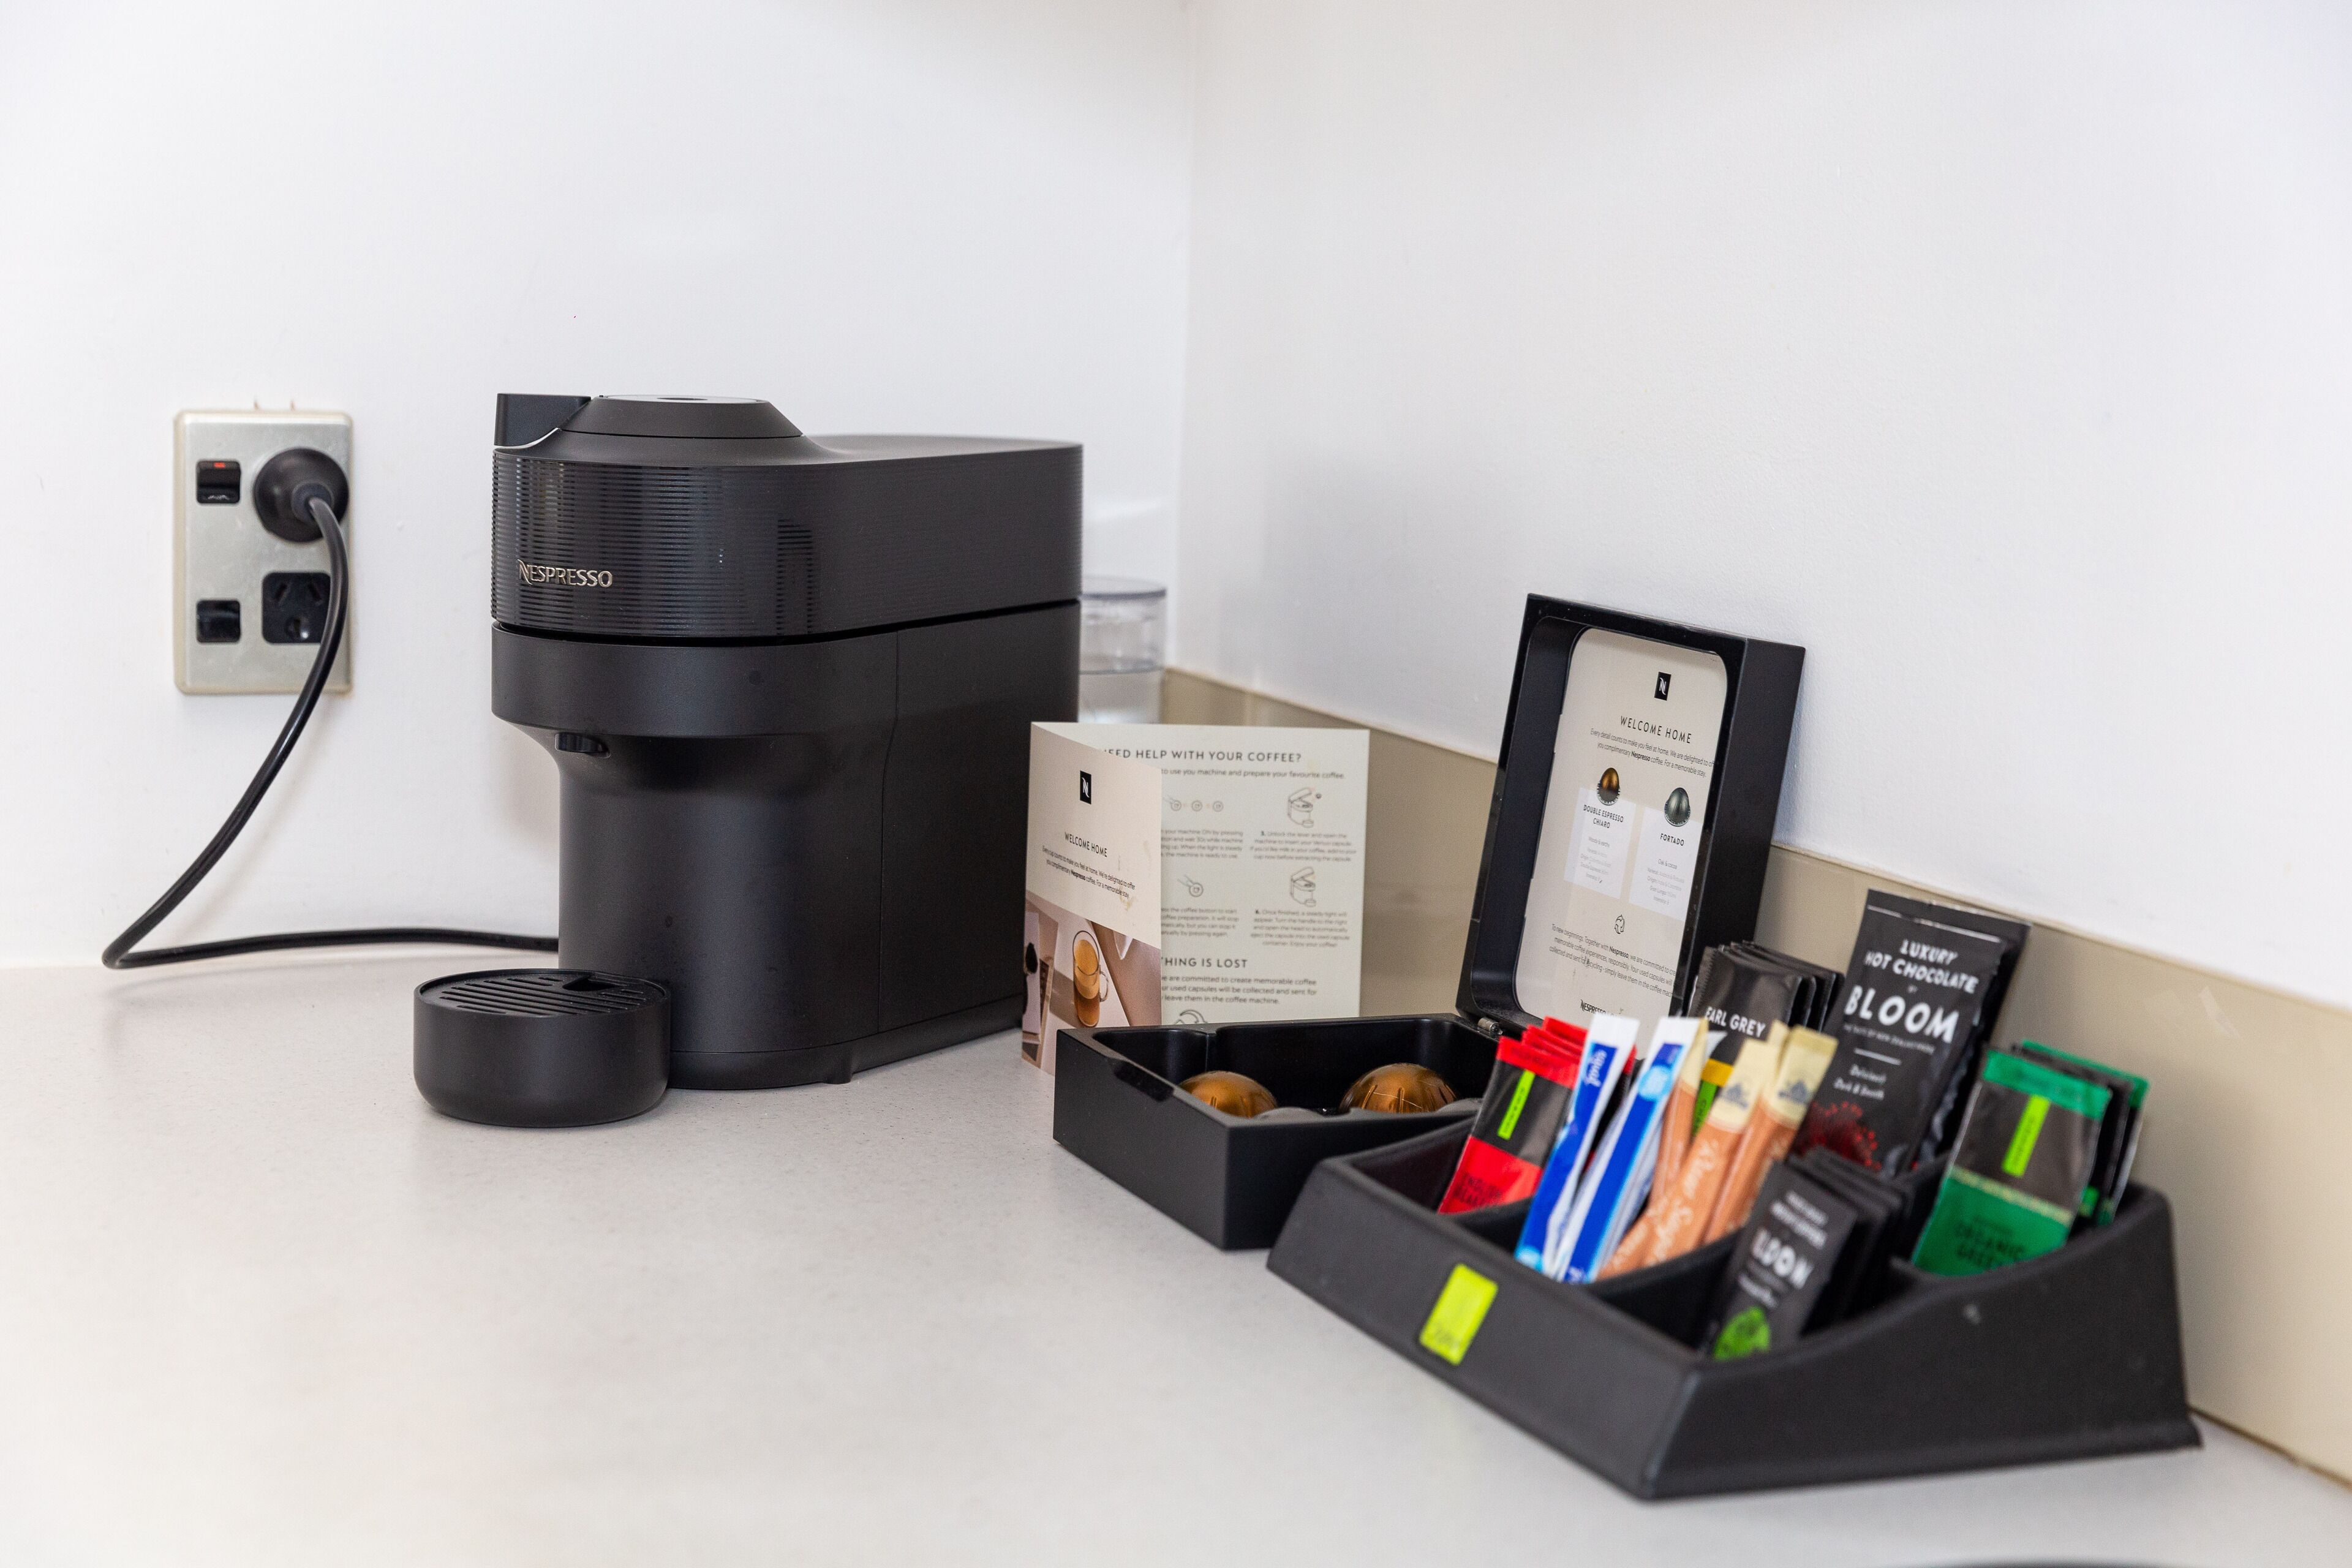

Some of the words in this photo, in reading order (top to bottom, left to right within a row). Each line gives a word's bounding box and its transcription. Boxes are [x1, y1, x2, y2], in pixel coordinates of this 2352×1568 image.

[517, 559, 613, 588] NESPRESSO
[1620, 715, 1662, 736] WELCOME
[1665, 727, 1692, 744] HOME
[1136, 750, 1167, 759] HELP
[1172, 750, 1204, 760] WITH
[1209, 751, 1243, 761] YOUR
[1247, 752, 1302, 763] COFFEE?
[1630, 750, 1651, 762] Nespresso
[1583, 804, 1601, 816] DOUBLE
[1602, 810, 1624, 823] ESPRESSO
[1593, 818, 1610, 829] CHIARO
[1065, 832, 1090, 851] WELCOME
[1091, 843, 1107, 858] HOME
[1660, 833, 1684, 846] FORTADO
[1161, 957, 1197, 967] HING
[1202, 958, 1212, 967] IS
[1217, 959, 1248, 968] LOST
[1899, 939, 1959, 966] LUXURY
[1864, 951, 1892, 970] HOT
[1892, 959, 1980, 994] CHOCOLATE
[1705, 1006, 1727, 1027] EARL
[1729, 1014, 1766, 1038] GREY
[1844, 984, 1960, 1044] BLOOM
